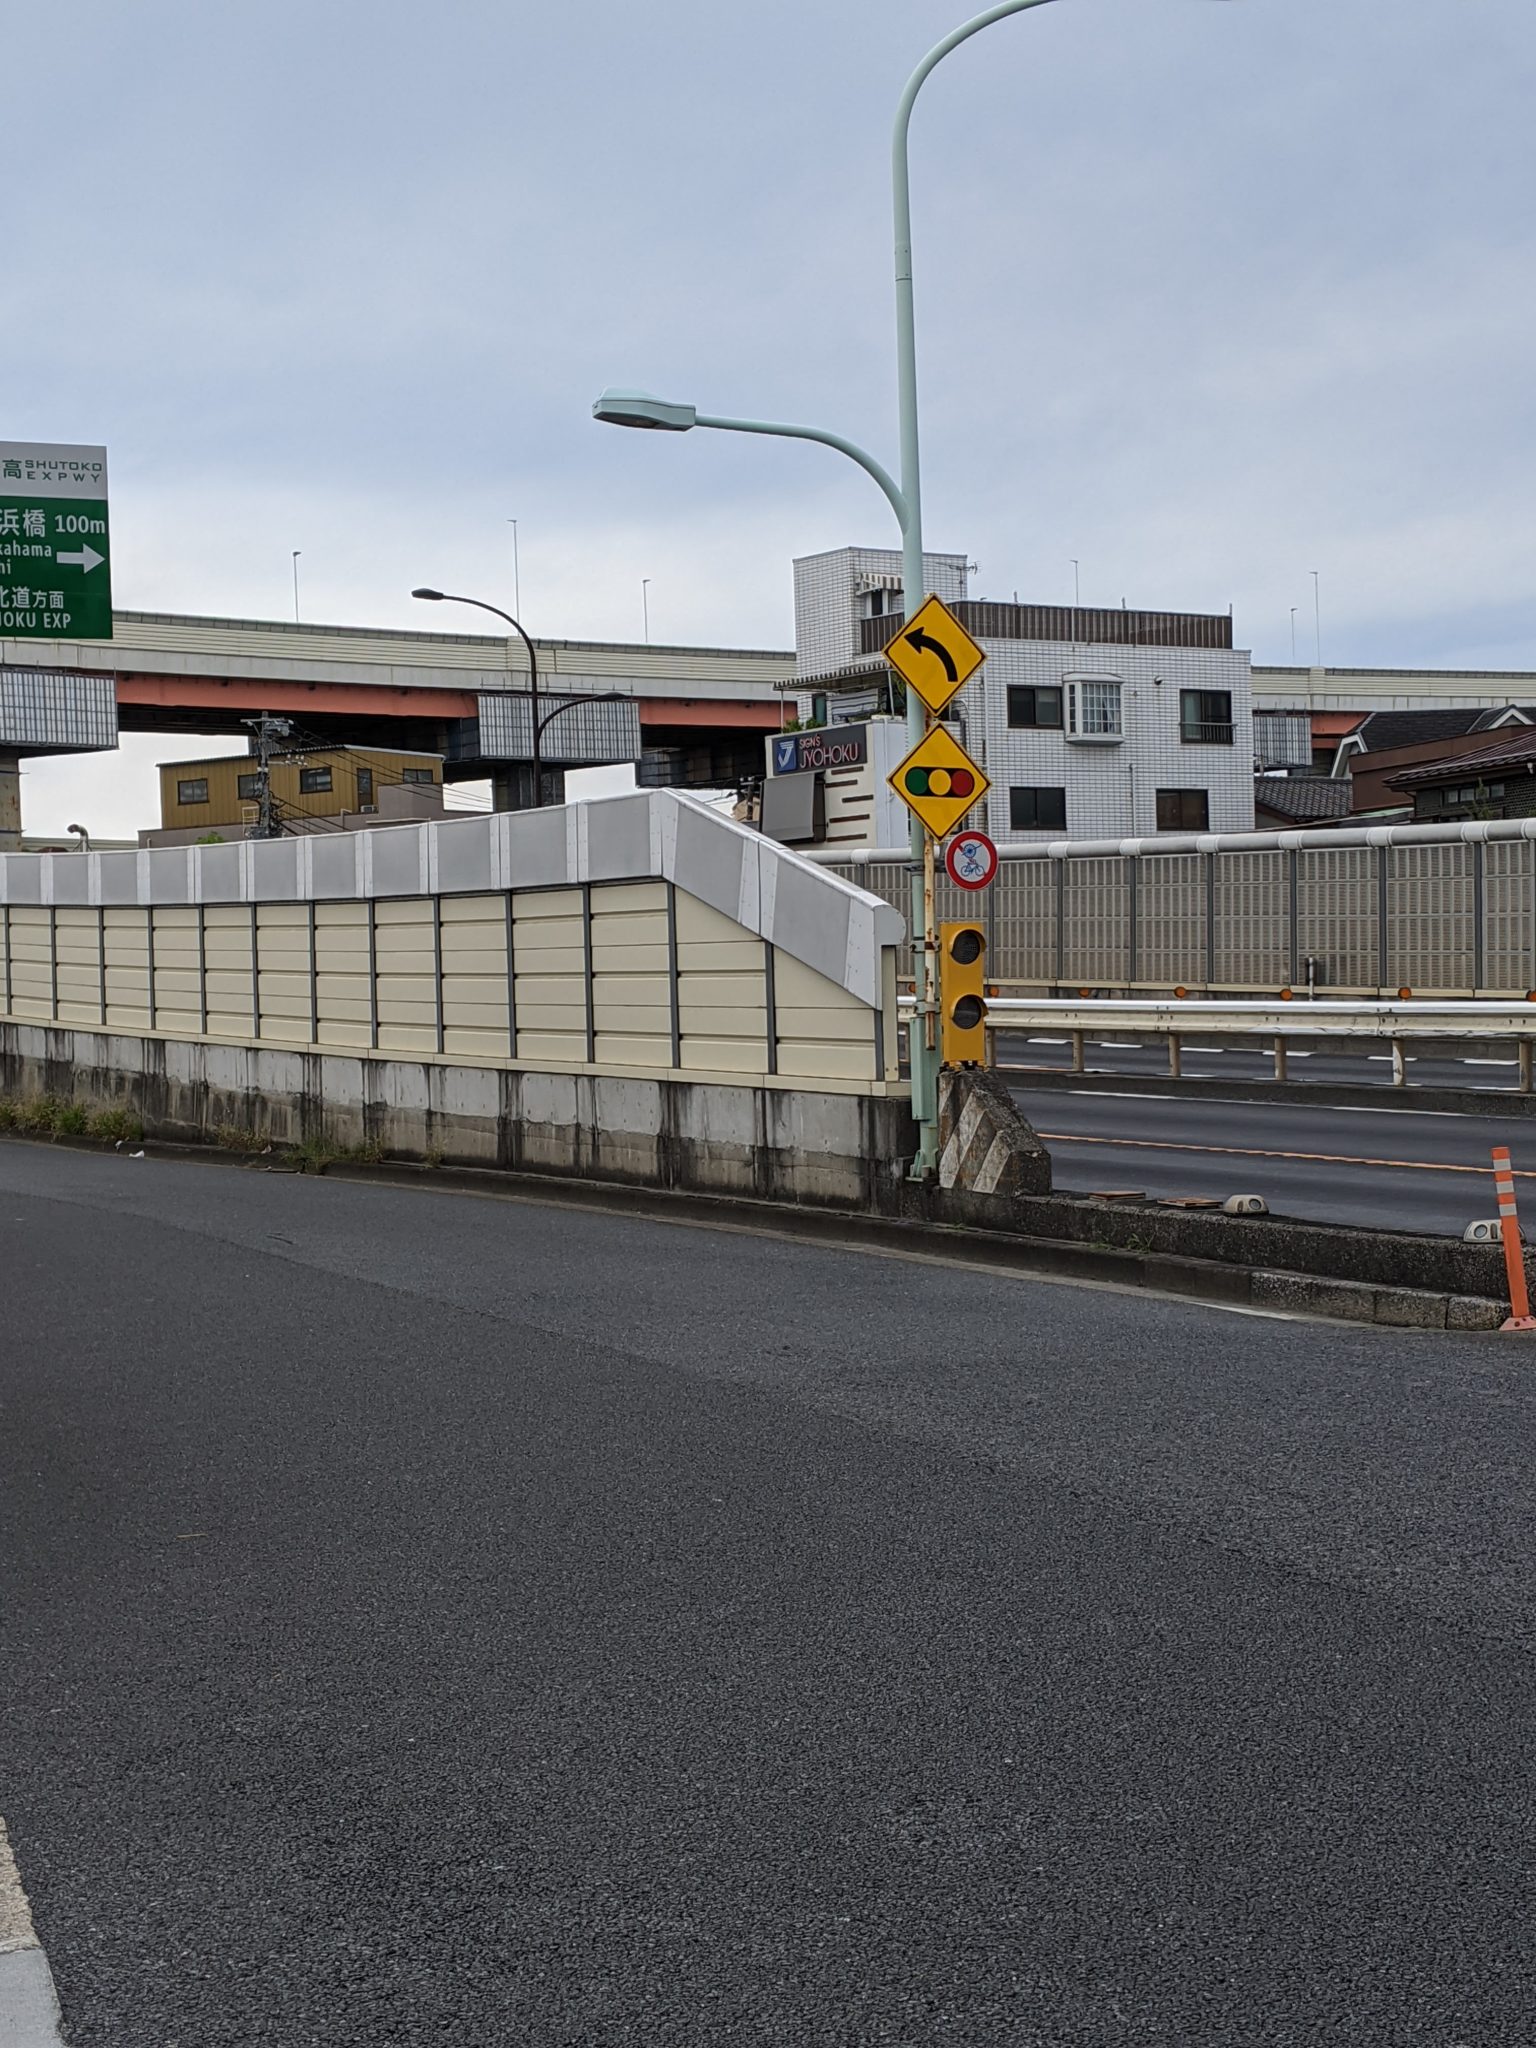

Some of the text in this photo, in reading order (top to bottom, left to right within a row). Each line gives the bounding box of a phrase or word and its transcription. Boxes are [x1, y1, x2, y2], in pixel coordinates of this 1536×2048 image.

[2, 458, 22, 479] 高
[25, 459, 102, 472] SHUTOKO
[55, 514, 105, 534] 100m
[0, 611, 71, 629] OKU EXP
[800, 742, 858, 769] JYOHOKU
